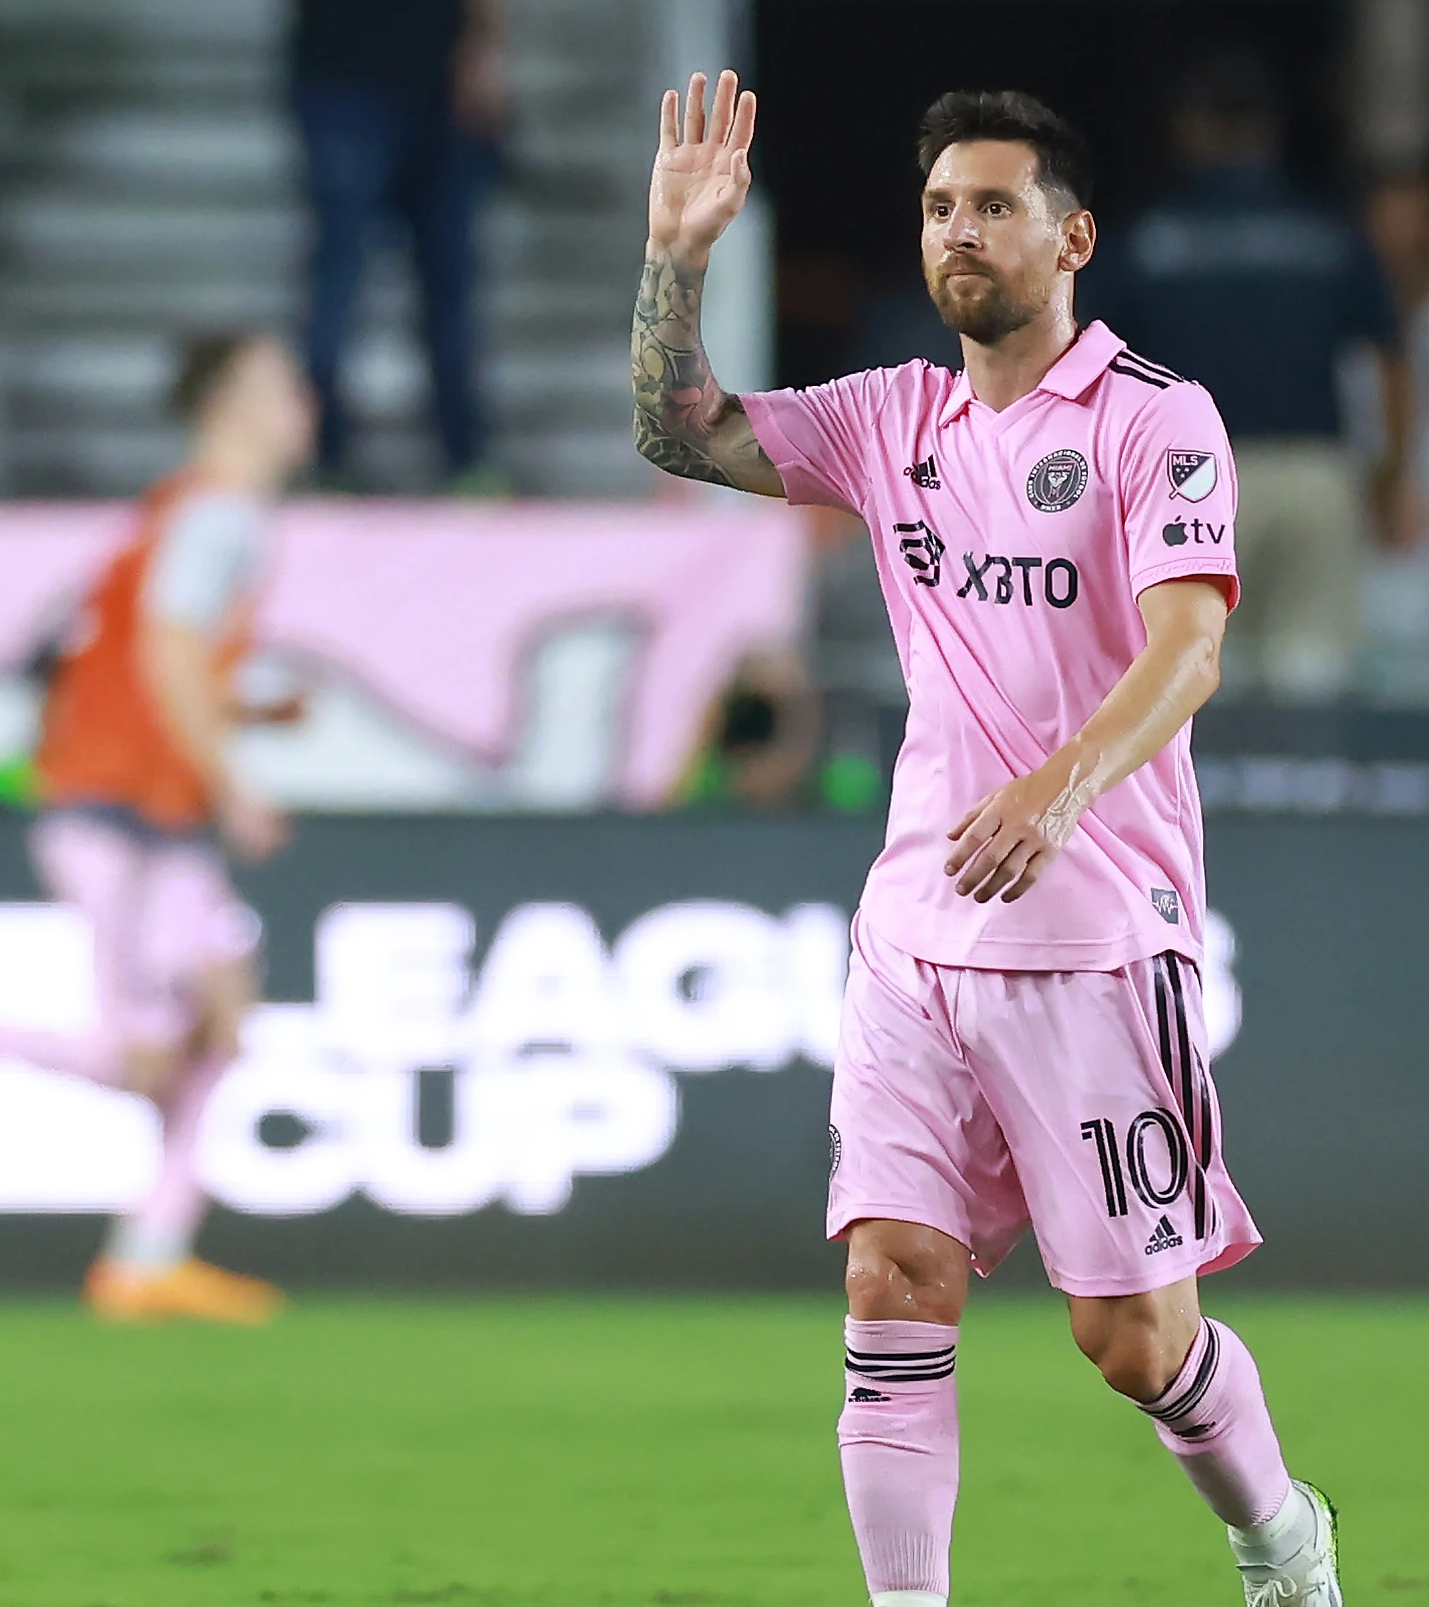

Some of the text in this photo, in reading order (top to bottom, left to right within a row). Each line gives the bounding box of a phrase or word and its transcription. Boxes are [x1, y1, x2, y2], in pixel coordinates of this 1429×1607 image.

[1172, 455, 1199, 466] MLS
[1190, 518, 1226, 544] tv
[956, 551, 1079, 609] XBTO
[193, 1055, 679, 1216] CUP
[1080, 1107, 1188, 1217] 10
[1145, 1235, 1183, 1256] adidas
